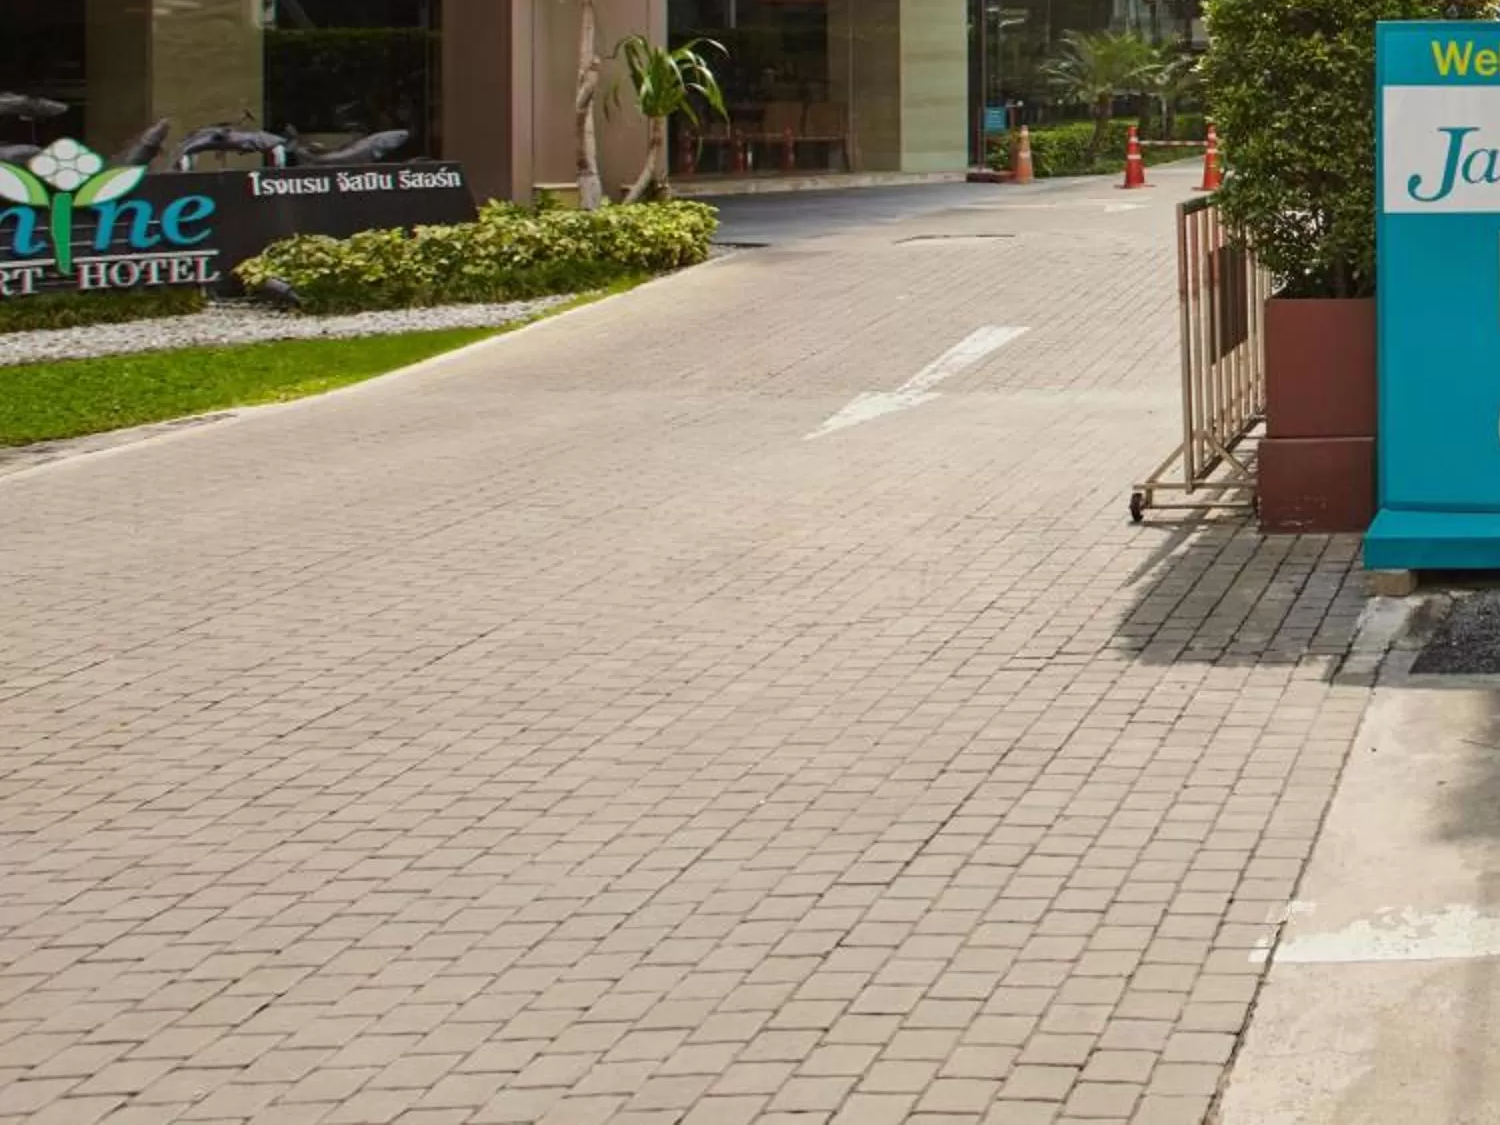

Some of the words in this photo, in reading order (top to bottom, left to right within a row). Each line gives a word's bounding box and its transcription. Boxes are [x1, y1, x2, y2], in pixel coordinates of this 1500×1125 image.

[249, 171, 330, 196] โรงแรม
[336, 171, 394, 192] จัสมิน
[398, 167, 462, 190] รีสอร์ท
[78, 255, 221, 290] HOTEL
